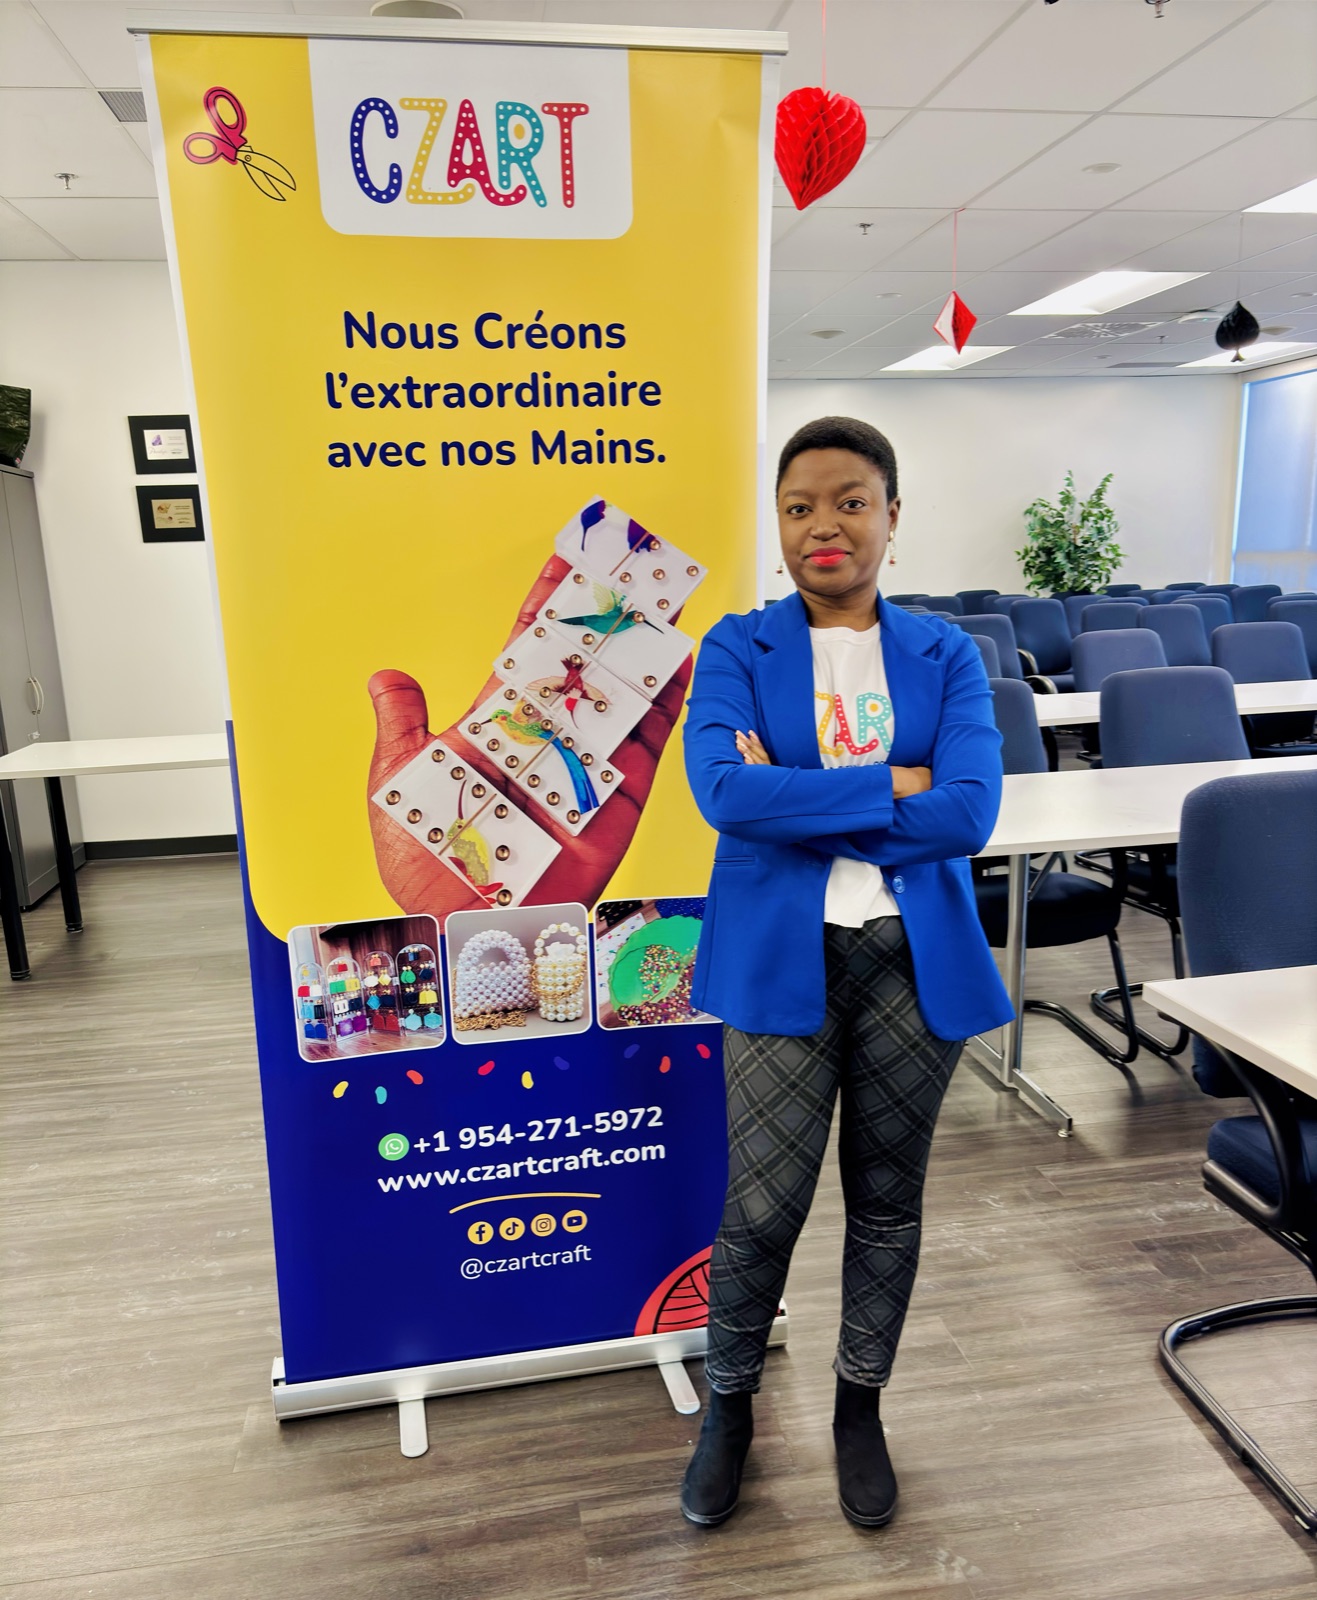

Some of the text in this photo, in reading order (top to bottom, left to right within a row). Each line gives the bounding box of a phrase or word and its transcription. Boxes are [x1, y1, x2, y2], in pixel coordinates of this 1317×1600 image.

[350, 97, 590, 208] CZART
[344, 309, 627, 350] Nous Créons
[327, 428, 666, 468] avec nos Mains.
[413, 1106, 664, 1154] +1 954-271-5972
[377, 1142, 667, 1193] www.czartcraft.com
[460, 1244, 592, 1280] @czartcraft
